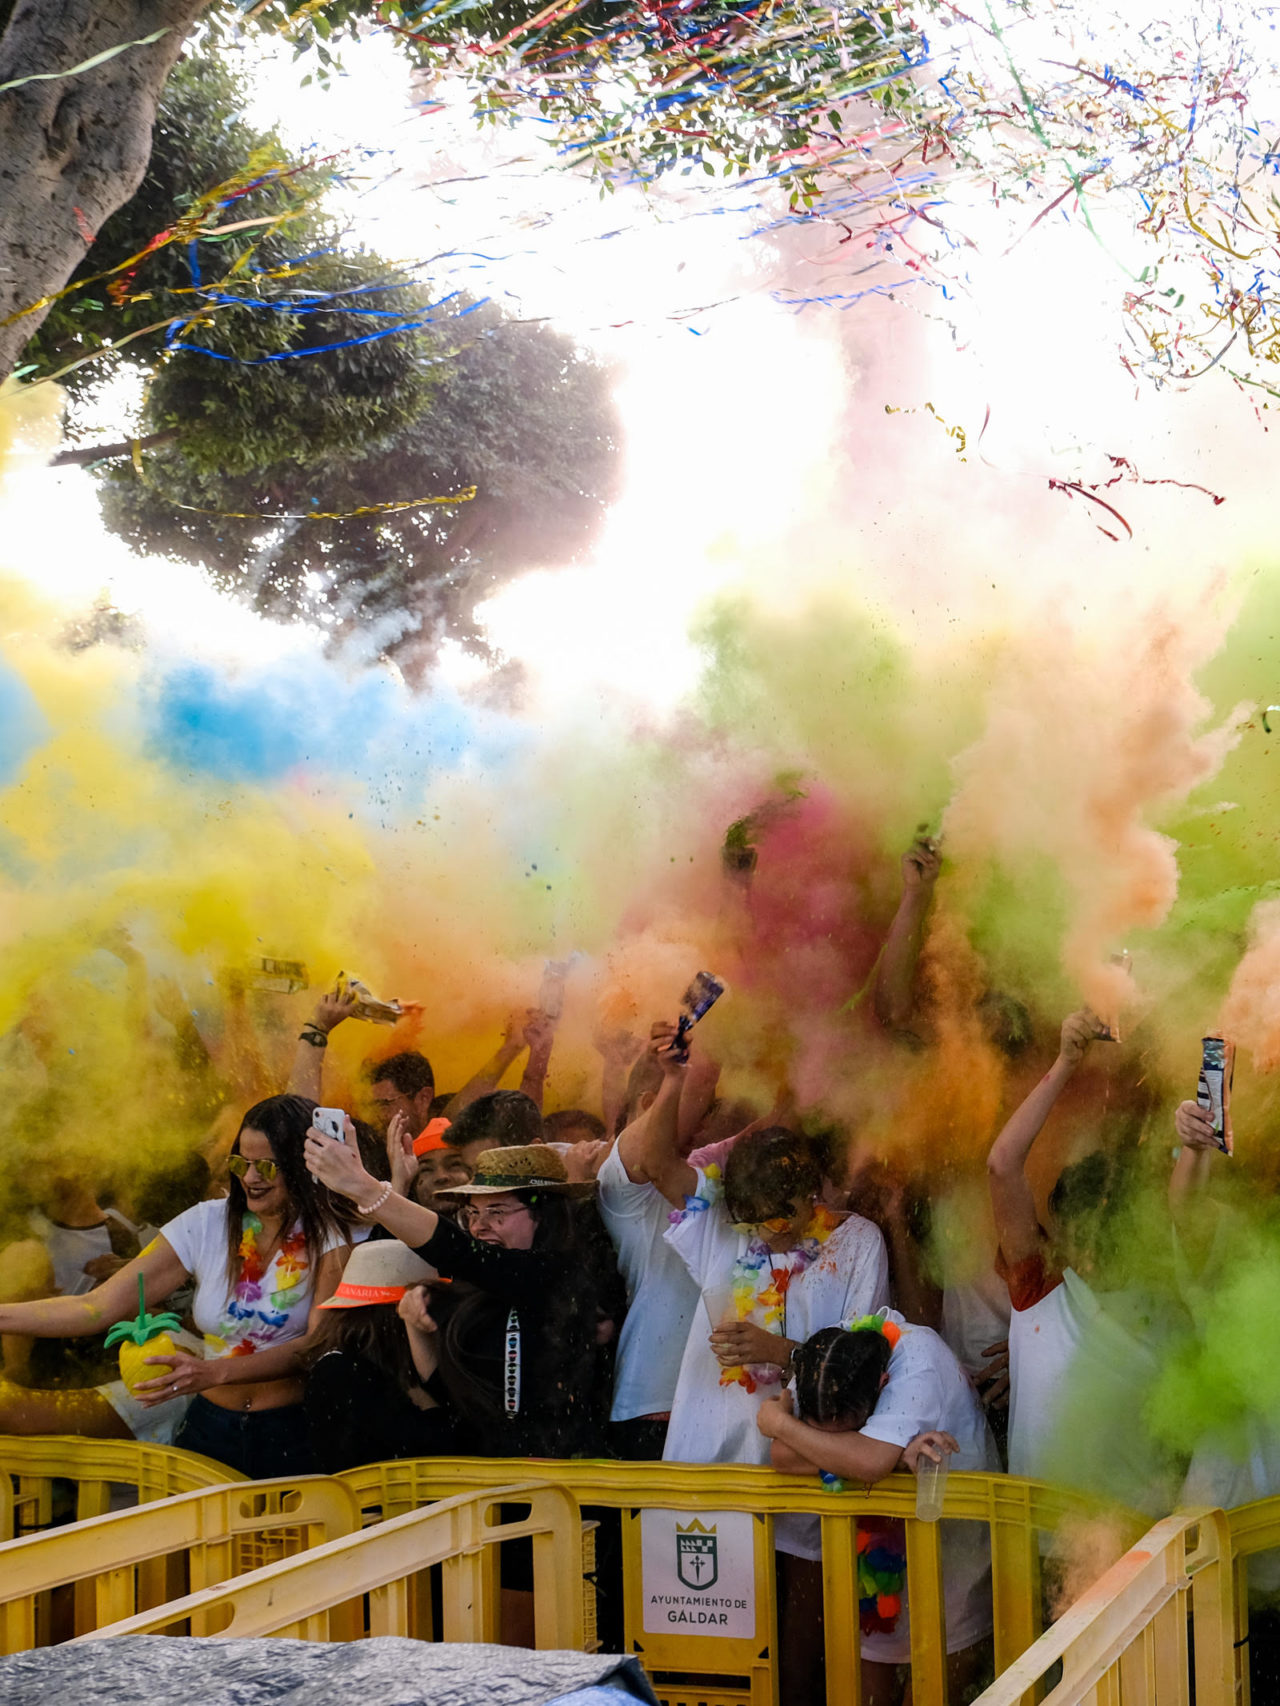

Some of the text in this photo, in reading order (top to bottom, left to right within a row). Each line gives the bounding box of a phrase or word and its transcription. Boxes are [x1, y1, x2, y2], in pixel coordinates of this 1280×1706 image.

[651, 1595, 748, 1609] AYUNTAMIENTO DE
[667, 1609, 728, 1625] GÁLDAR
